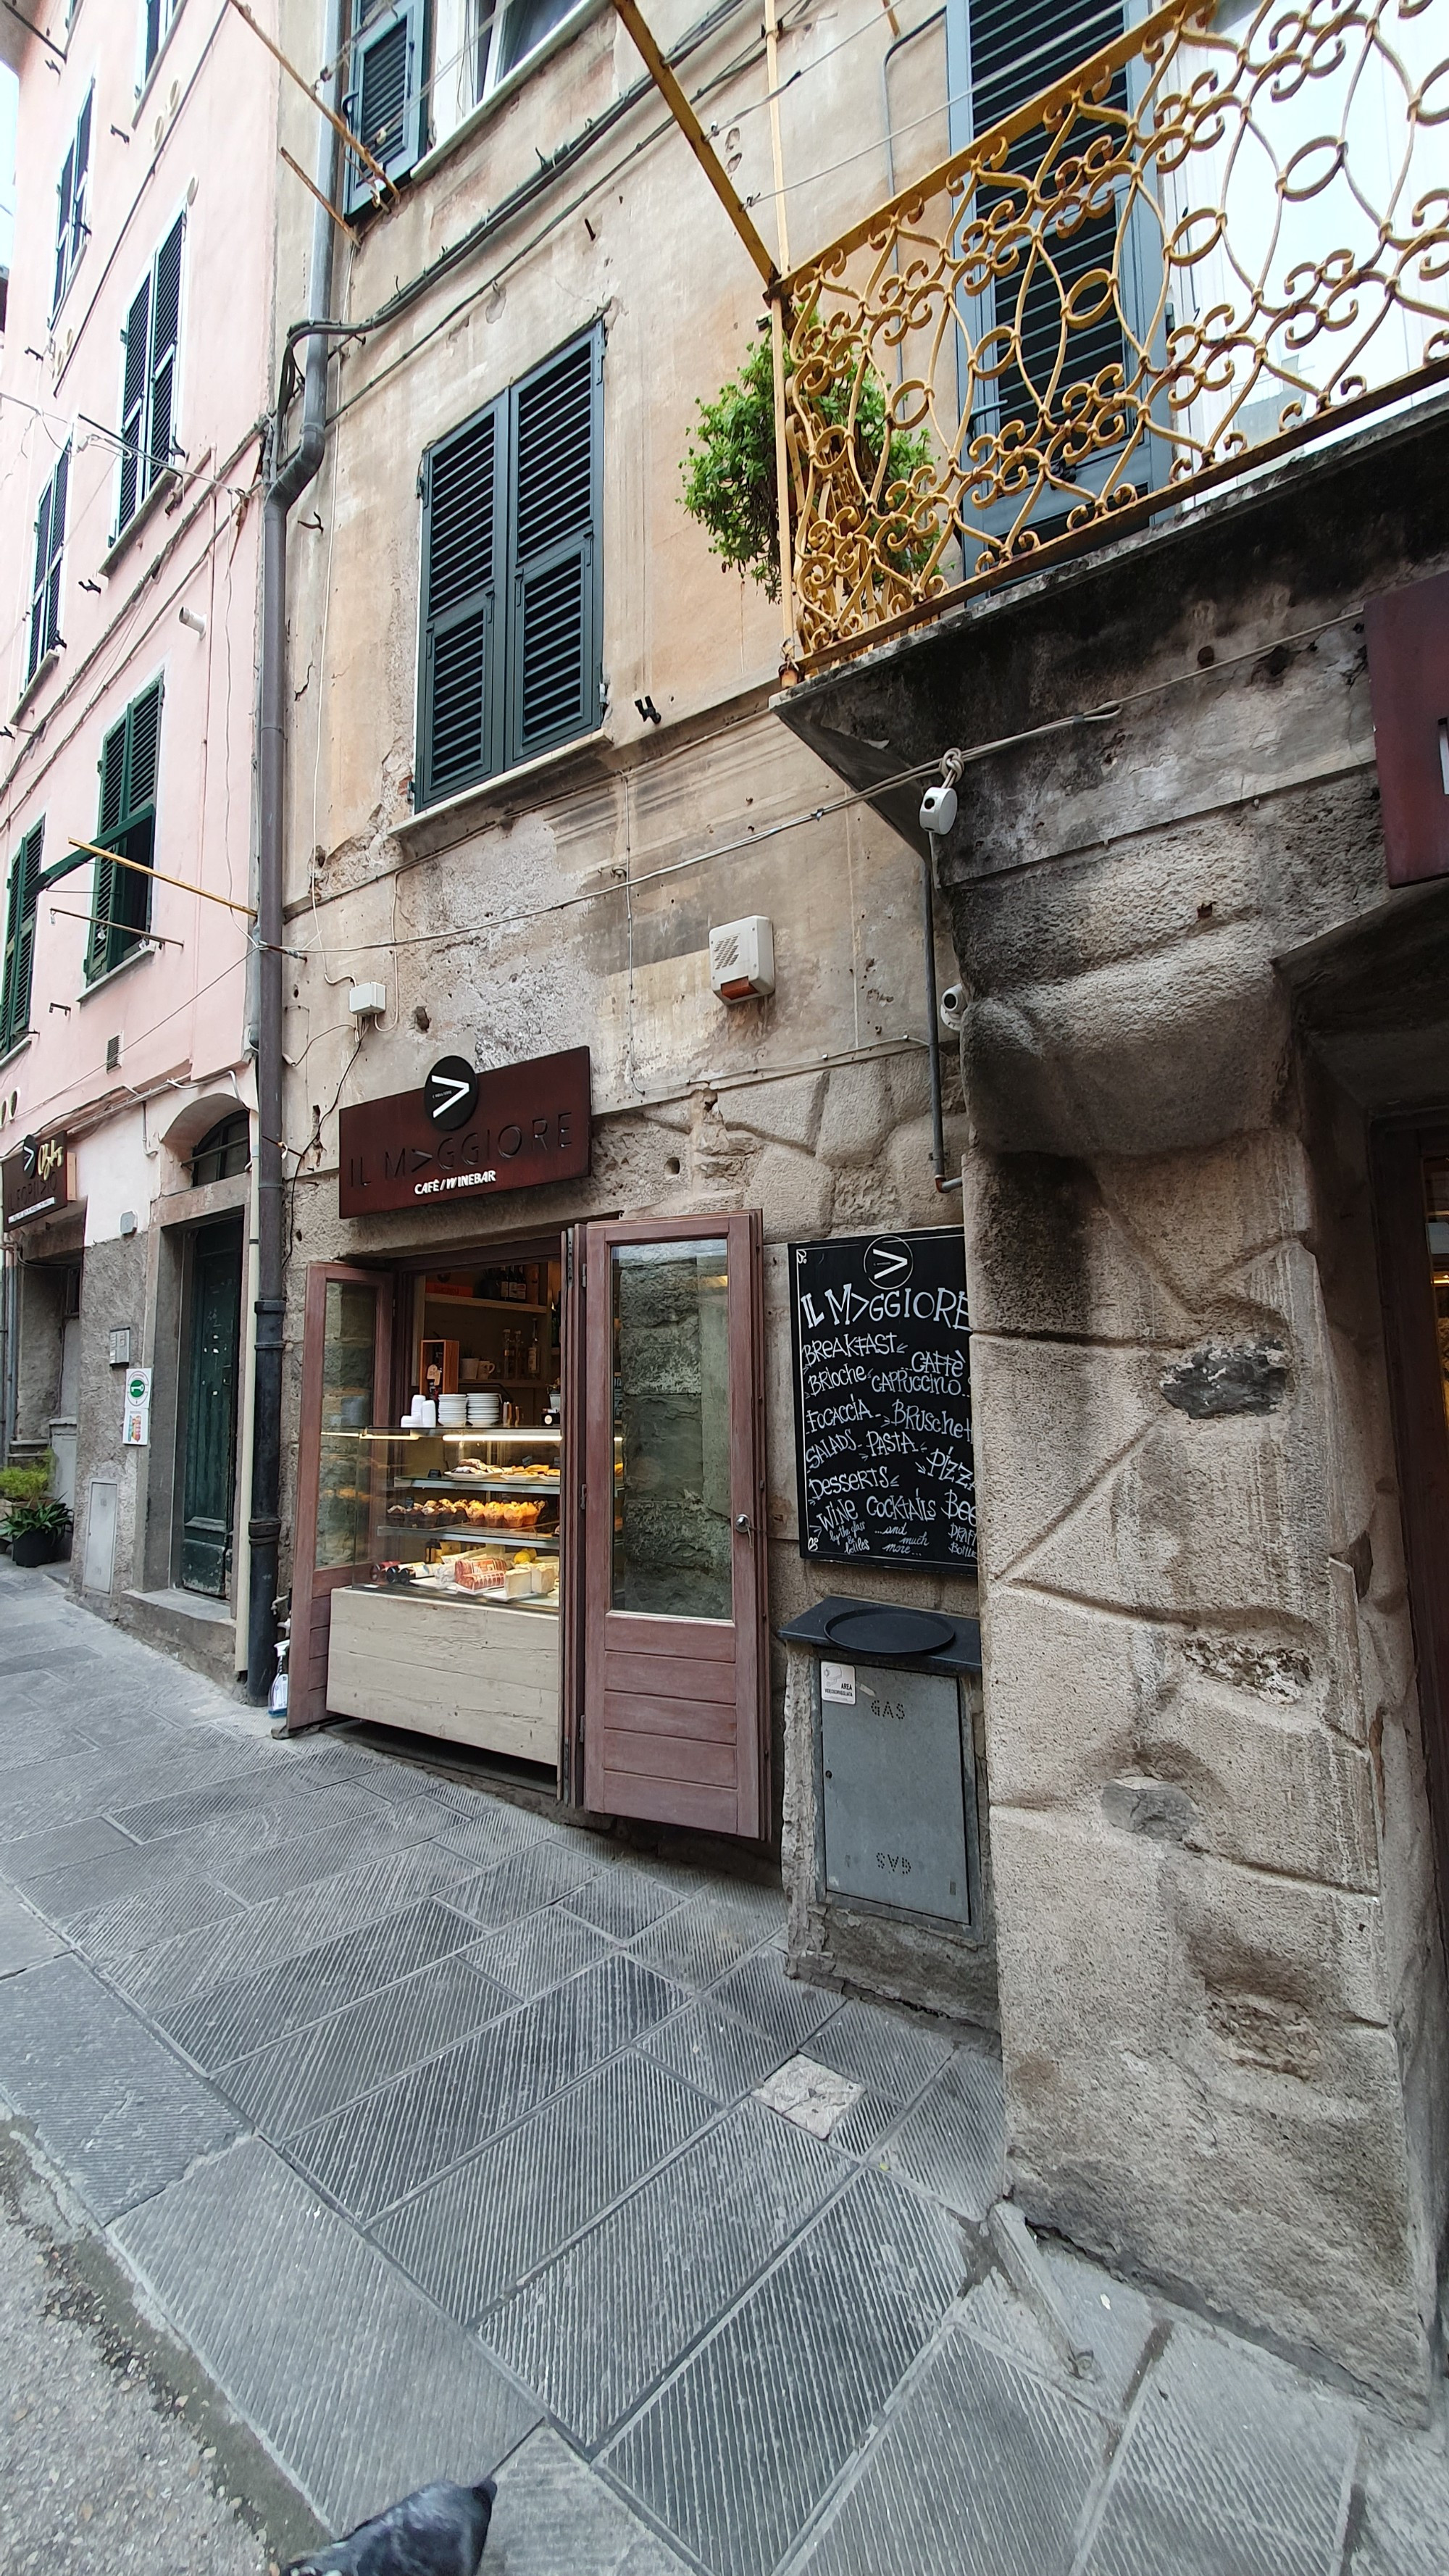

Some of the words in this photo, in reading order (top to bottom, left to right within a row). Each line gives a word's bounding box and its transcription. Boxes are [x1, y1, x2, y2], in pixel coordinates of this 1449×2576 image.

[351, 1156, 372, 1188] IL
[801, 1293, 825, 1329] IL
[866, 1430, 919, 1457] PASTA
[926, 1446, 975, 1491] PiZZ
[830, 1530, 840, 1546] by
[838, 1525, 851, 1538] the
[851, 1520, 865, 1538] glass
[847, 1535, 855, 1544] &
[899, 1531, 930, 1546] much
[871, 1699, 905, 1720] GAS
